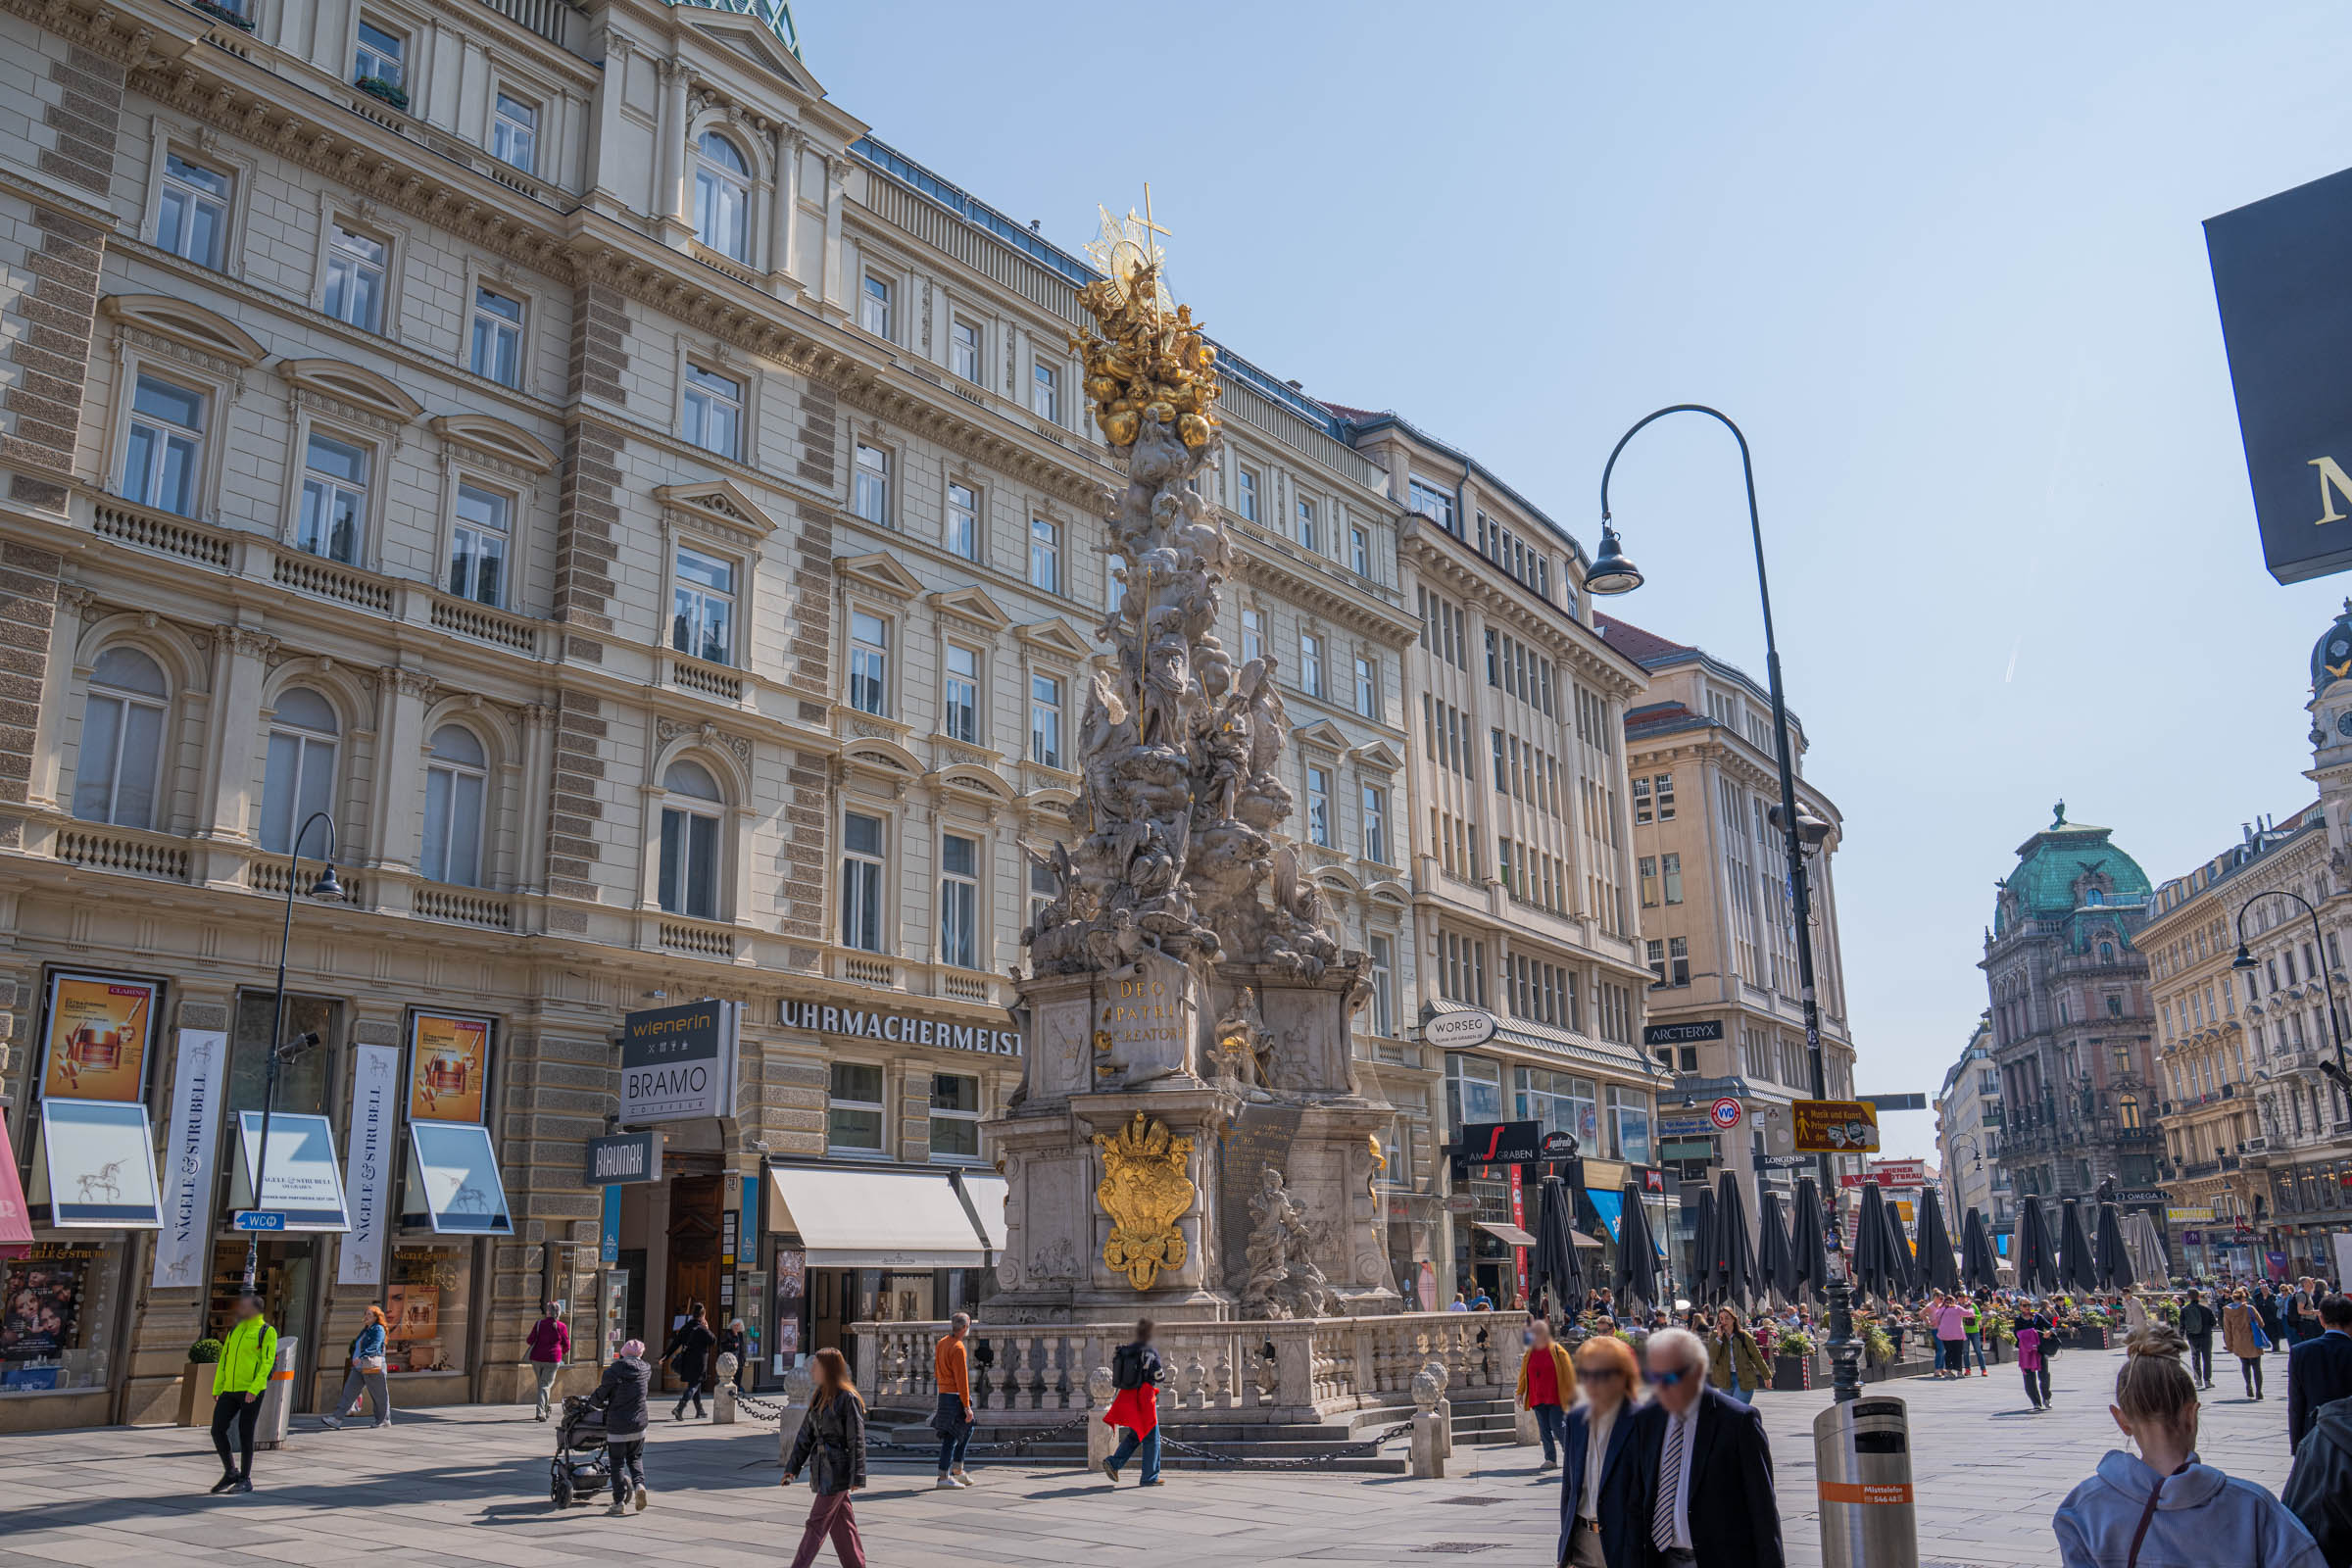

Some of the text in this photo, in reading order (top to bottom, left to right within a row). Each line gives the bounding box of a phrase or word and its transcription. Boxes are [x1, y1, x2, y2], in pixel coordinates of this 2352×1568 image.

[1120, 980, 1165, 998] DEO
[1116, 1003, 1174, 1021] PATRI
[780, 1000, 1022, 1057] UHRMACHERMEIST
[1435, 1019, 1483, 1033] WORSEG
[1113, 1026, 1183, 1043] CREATORI
[629, 1066, 707, 1099] BRAMO
[630, 1100, 703, 1114] COIFFEUR
[1718, 1107, 1736, 1119] VVD
[1810, 1109, 1828, 1119] Musik
[1815, 1132, 1827, 1142] der
[175, 1073, 207, 1243] NÄGELE & STRUBELL
[1469, 1152, 1484, 1161] AM
[1495, 1149, 1533, 1159] GRABEN
[1765, 1155, 1805, 1164] LONGINES
[357, 1085, 381, 1243] NÄGELE & STRUBELL
[2127, 1192, 2157, 1200] OMEGA
[249, 1215, 266, 1227] WC
